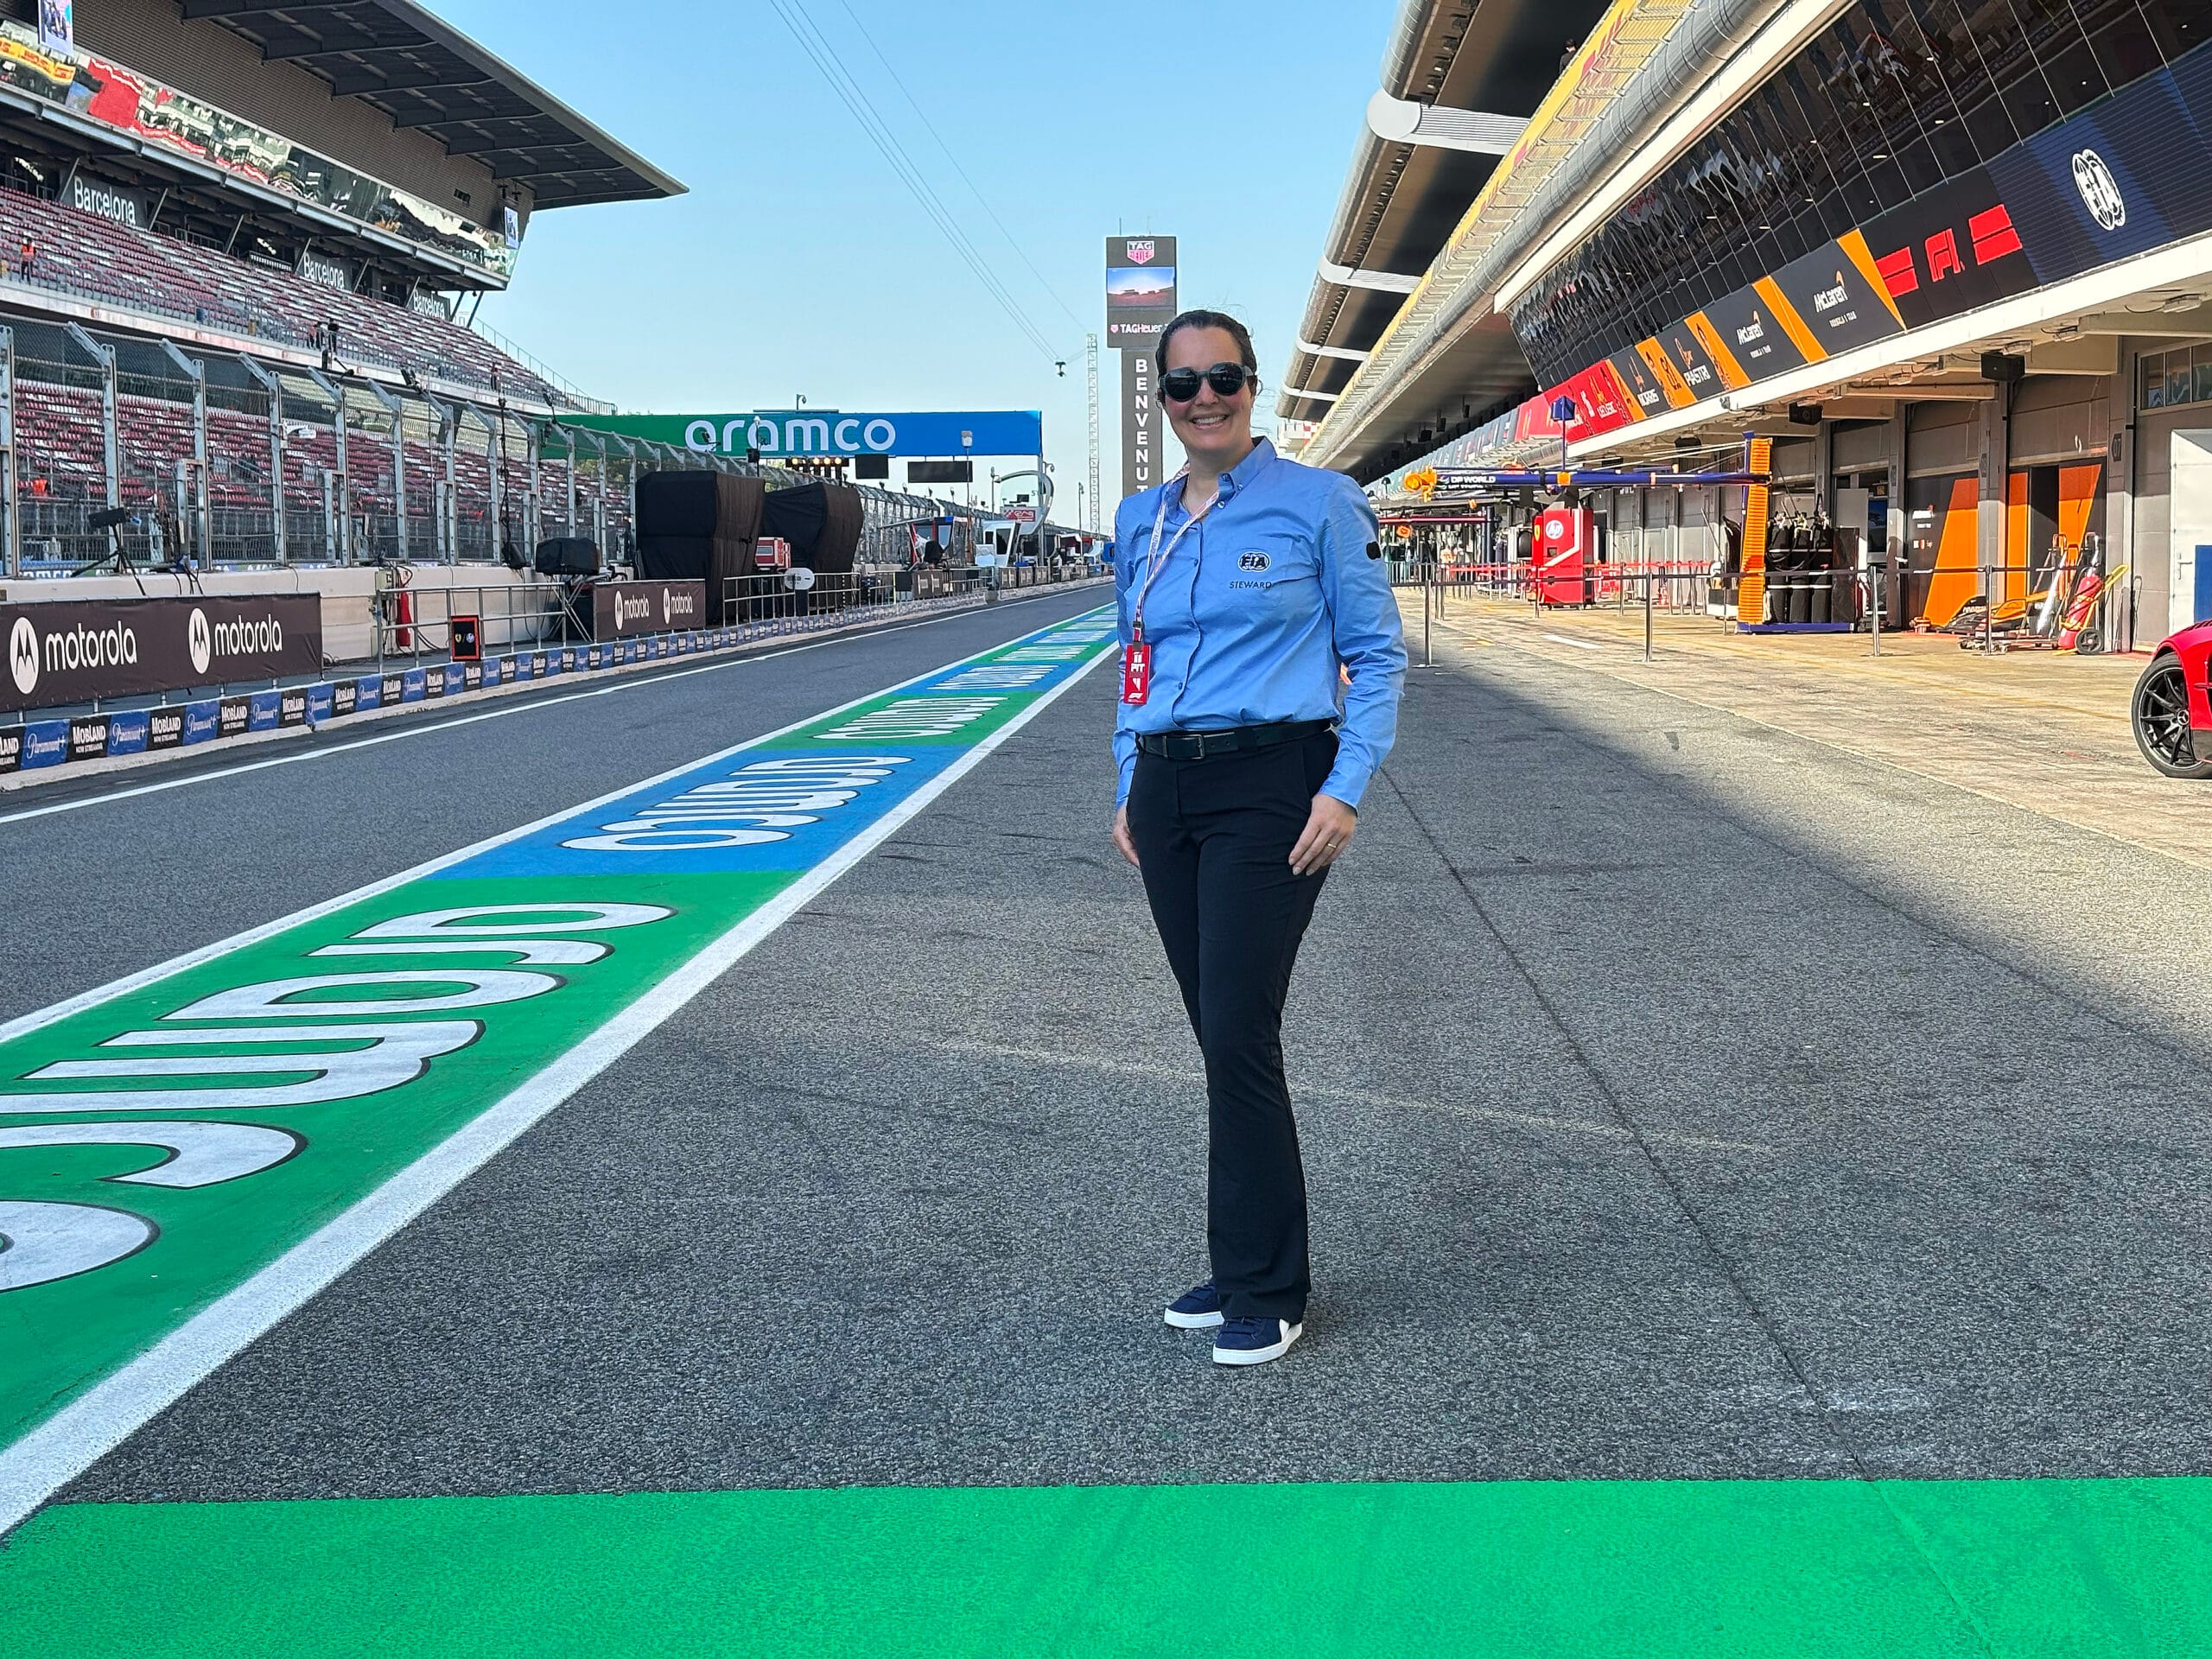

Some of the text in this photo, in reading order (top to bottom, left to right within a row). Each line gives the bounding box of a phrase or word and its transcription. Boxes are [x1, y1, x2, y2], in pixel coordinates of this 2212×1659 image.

[74, 175, 136, 226] Barcelona
[303, 253, 344, 289] Barcelona
[413, 289, 444, 319] Barcelona
[1814, 285, 1848, 313] McLaren
[1736, 323, 1764, 345] McLaren
[1683, 365, 1712, 387] PIASTRI
[685, 419, 896, 452] aramco
[1230, 581, 1273, 589] STEWARD
[624, 594, 649, 620] motorola
[671, 591, 692, 614] motorola
[45, 620, 137, 672] motorola
[215, 613, 283, 657] motorola
[1130, 664, 1145, 672] PIT
[73, 724, 105, 744] MOBLAND
